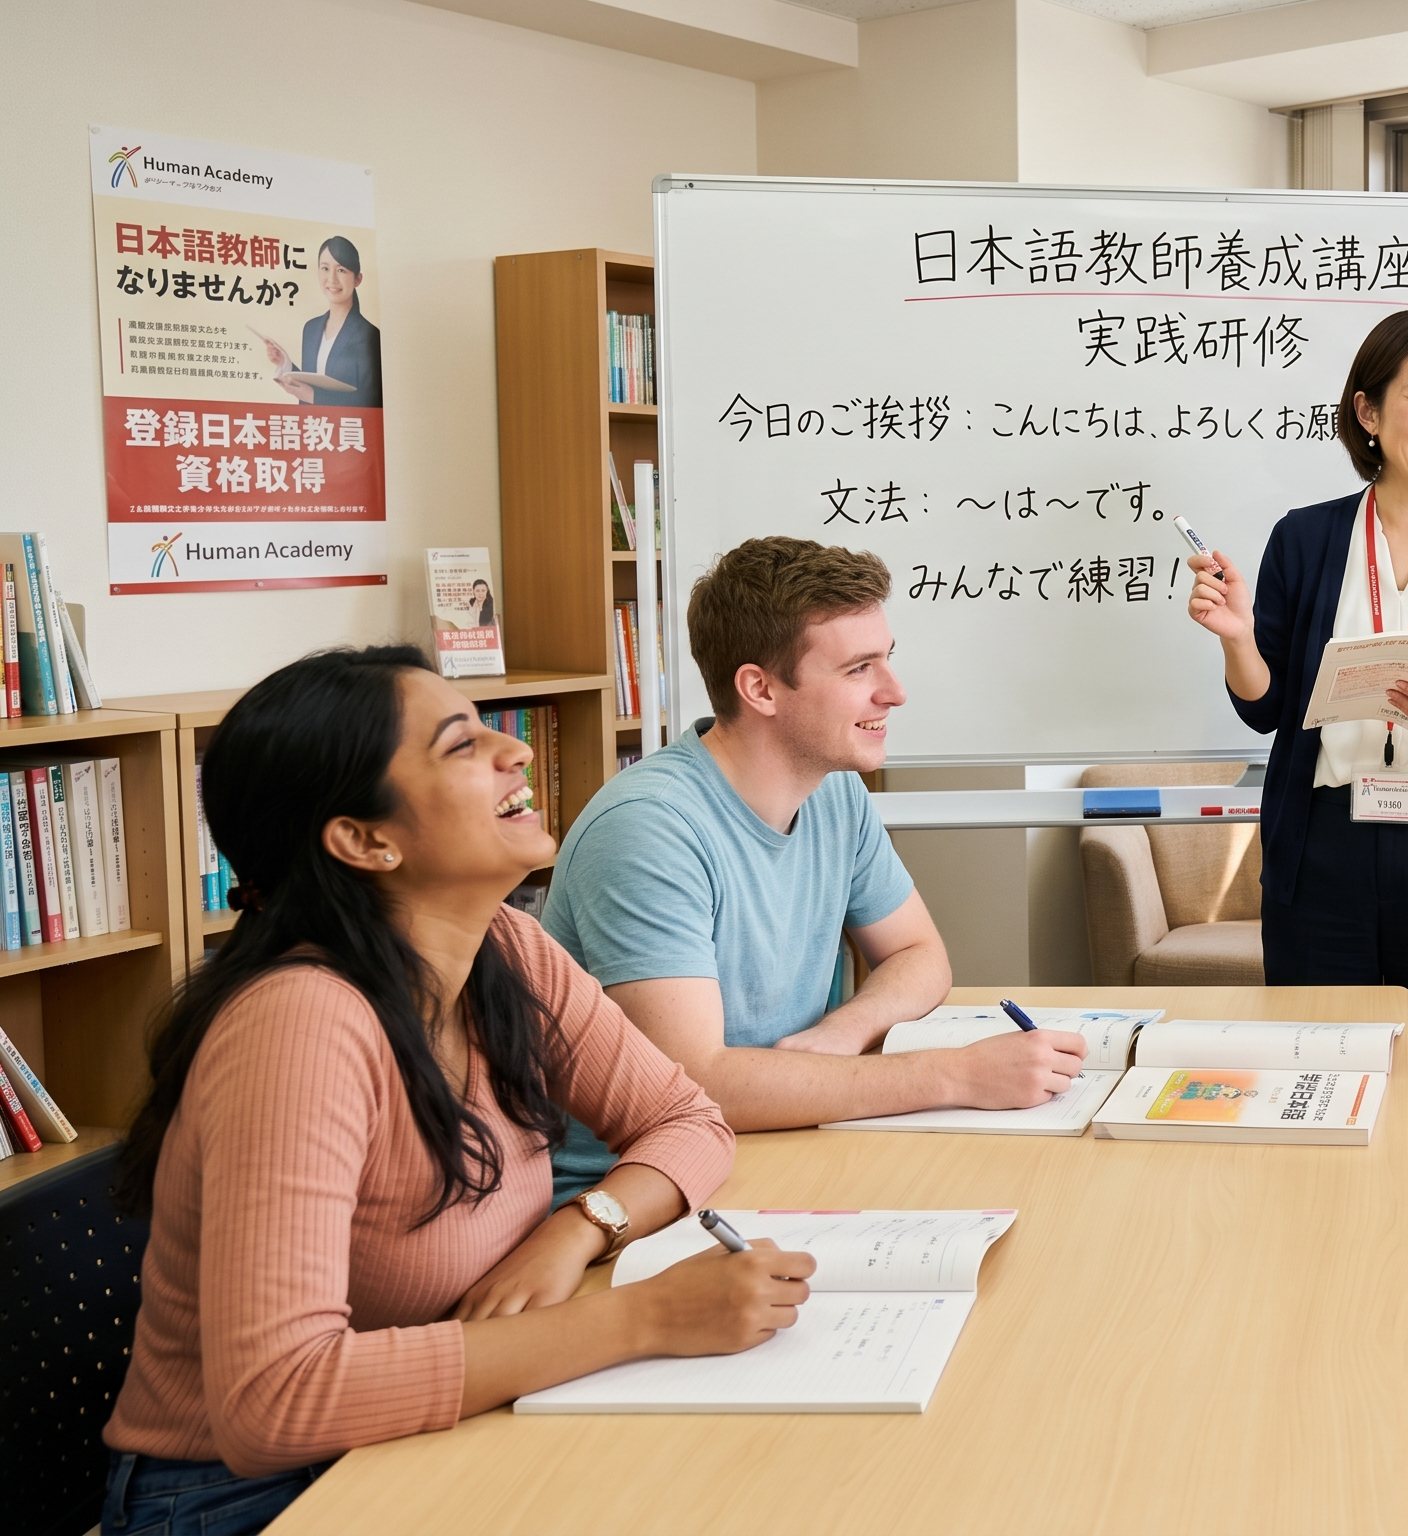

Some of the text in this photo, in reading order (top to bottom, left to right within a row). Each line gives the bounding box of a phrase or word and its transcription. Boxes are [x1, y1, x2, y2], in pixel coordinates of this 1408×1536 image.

[143, 156, 200, 177] Human
[204, 165, 274, 190] Academy
[115, 221, 308, 270] 日本語教師に
[116, 264, 300, 307] なりませんか?
[1077, 308, 1310, 369] 実践研修
[123, 408, 367, 452] 登録日本語教員
[175, 454, 326, 493] 資格取得
[186, 539, 354, 562] Human Academy
